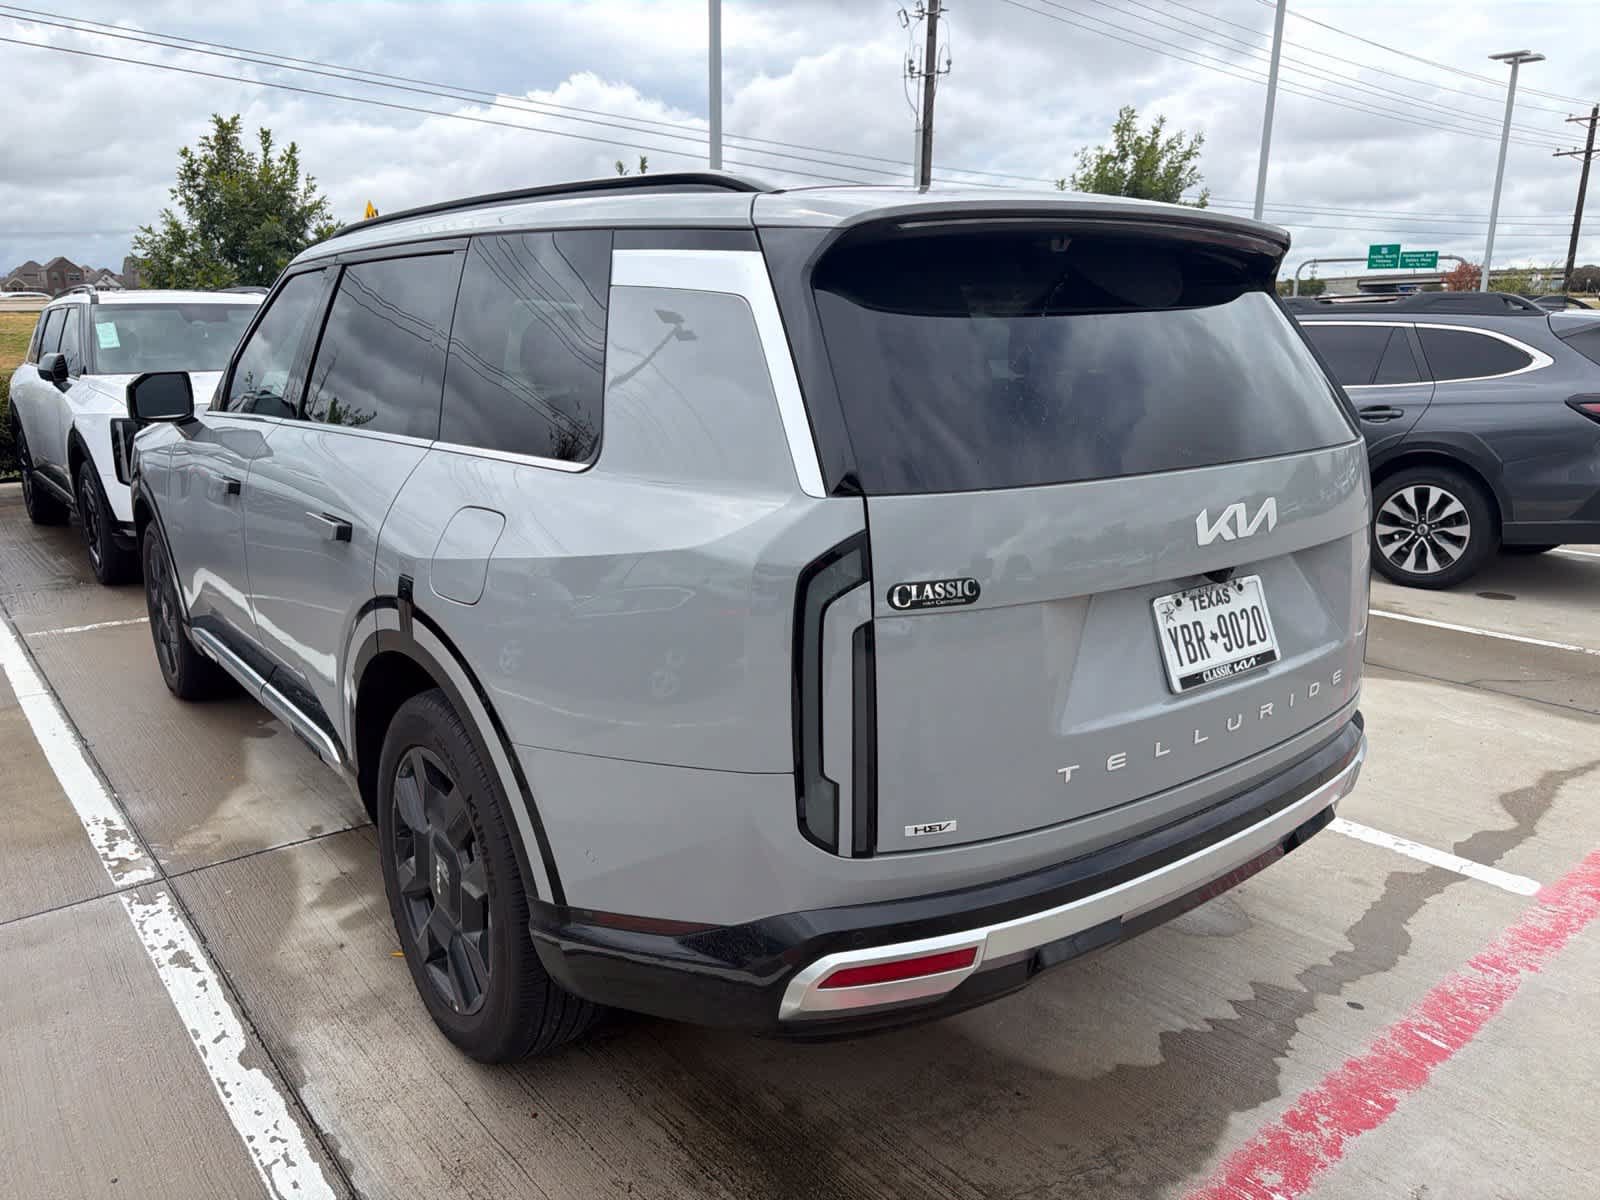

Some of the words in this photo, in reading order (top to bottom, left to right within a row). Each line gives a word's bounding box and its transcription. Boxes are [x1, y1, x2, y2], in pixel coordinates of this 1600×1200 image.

[1195, 496, 1278, 546] KIA
[892, 579, 977, 608] CLASSIC
[1189, 588, 1231, 612] TEXAS
[1167, 620, 1211, 667] YBR
[1216, 605, 1267, 653] 9020
[1202, 663, 1233, 682] CLASSIC
[1233, 657, 1256, 672] KIA
[1057, 669, 1342, 784] TELLURIDE
[914, 822, 951, 835] HEV
